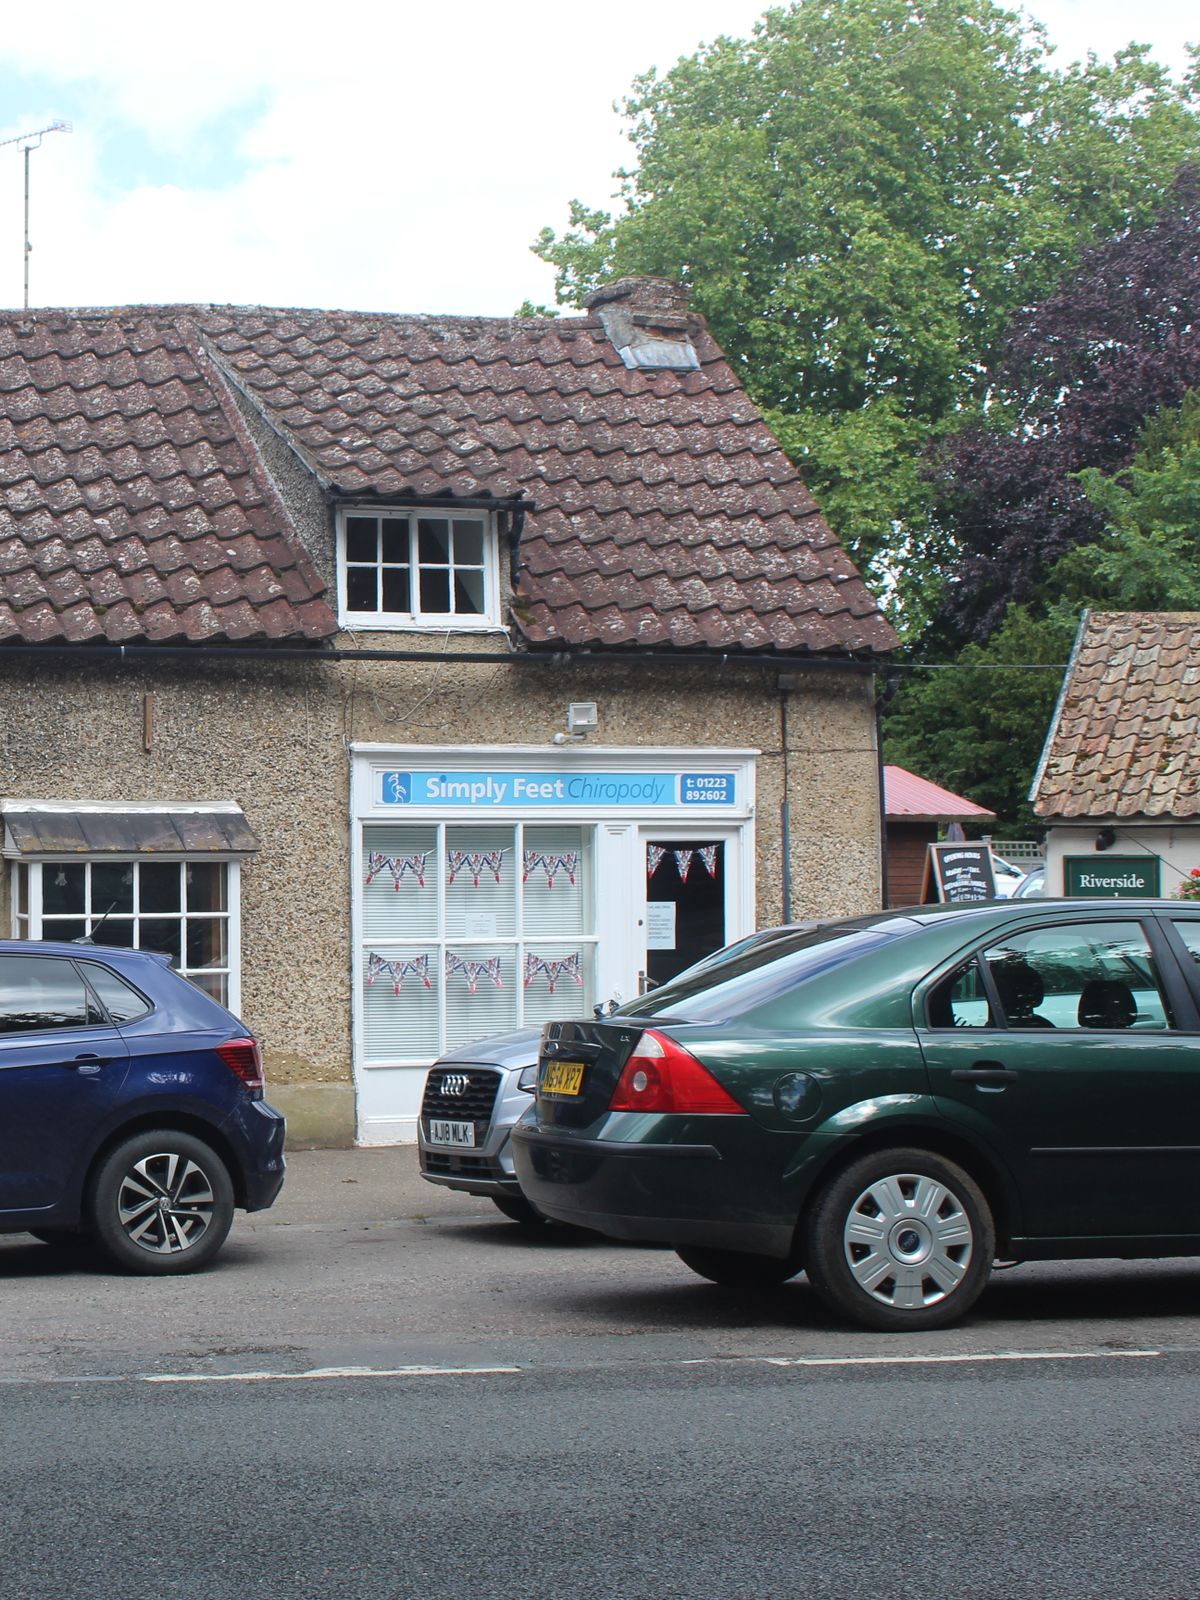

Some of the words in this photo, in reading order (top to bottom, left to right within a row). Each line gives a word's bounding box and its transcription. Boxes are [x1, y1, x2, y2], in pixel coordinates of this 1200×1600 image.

[426, 775, 507, 803] Simply
[513, 777, 565, 798] Feet
[568, 778, 665, 803] Chiropody
[696, 778, 727, 788] 01223
[686, 790, 727, 800] 892602
[1079, 873, 1145, 888] Riverside
